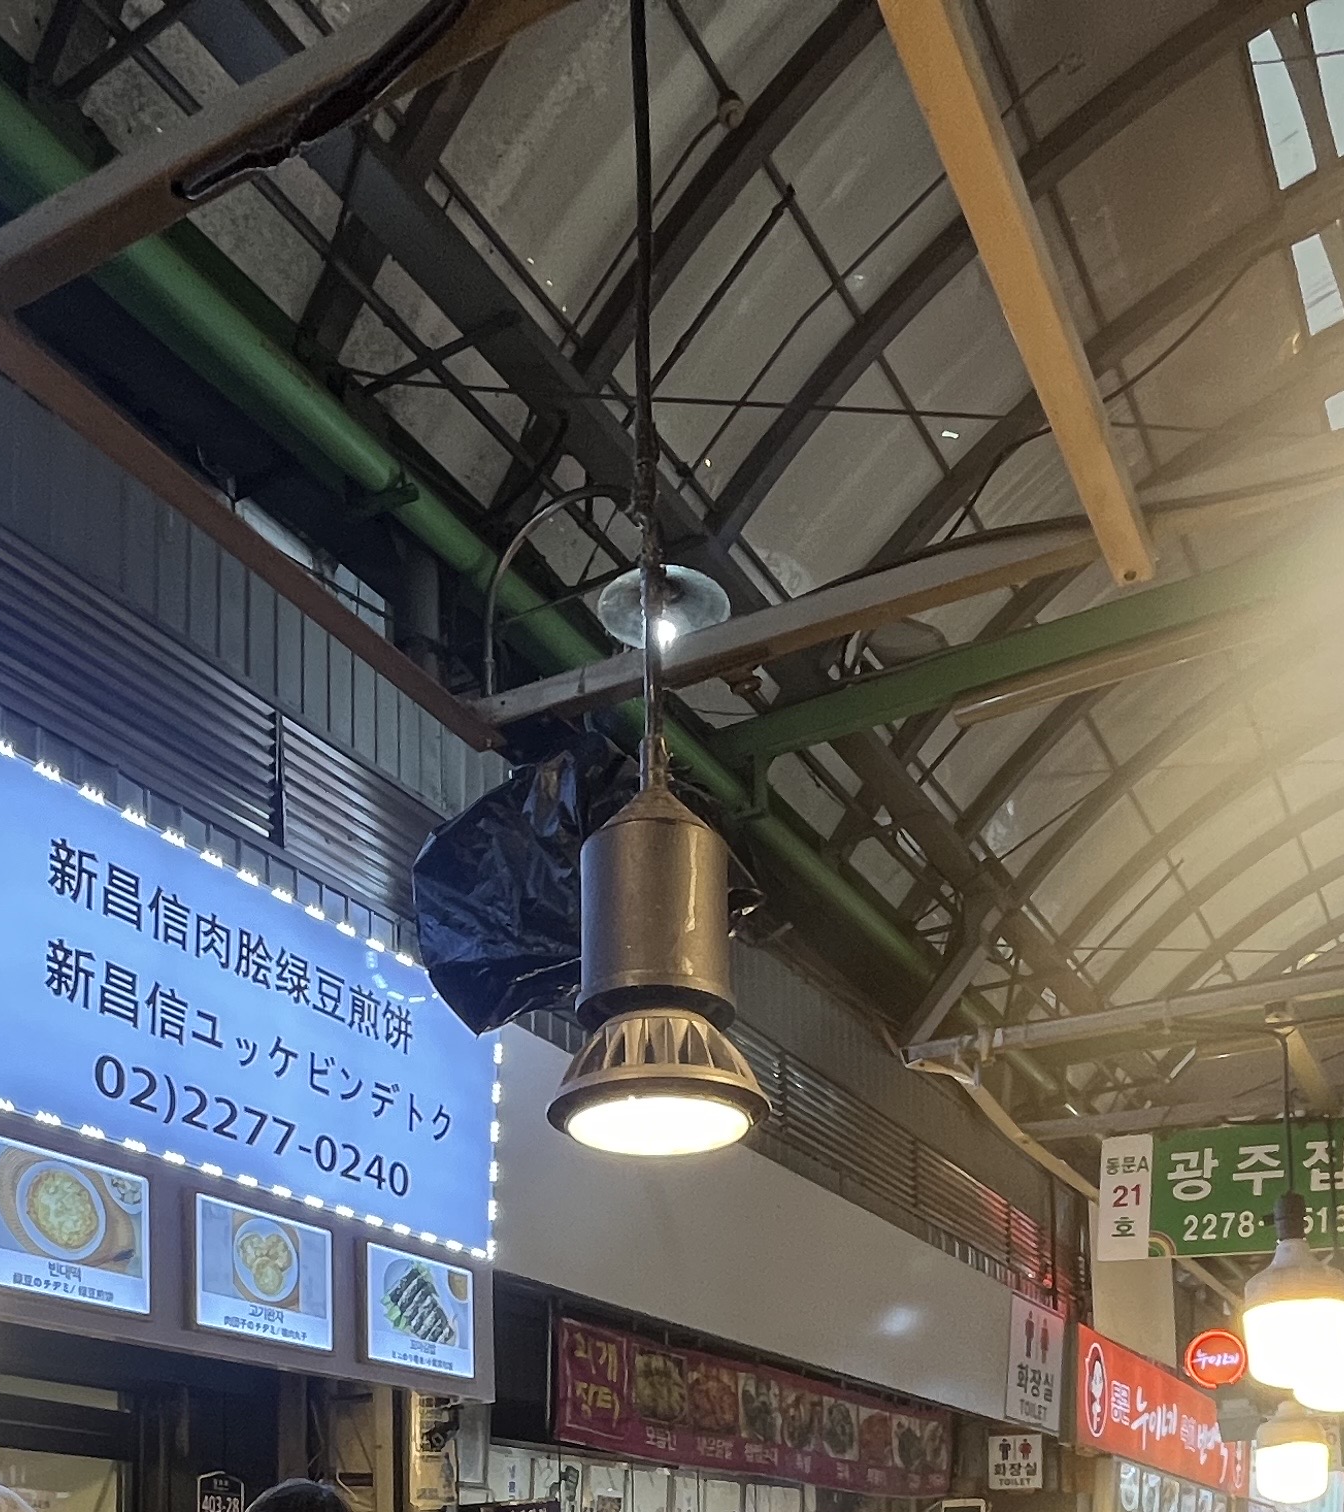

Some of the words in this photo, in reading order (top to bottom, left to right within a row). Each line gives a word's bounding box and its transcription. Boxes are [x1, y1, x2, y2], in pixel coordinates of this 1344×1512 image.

[48, 838, 413, 1054] 新昌信肉脍绿豆煎饼
[45, 938, 452, 1141] 新昌信ユッケビンデトク
[94, 1054, 409, 1197] 02)2277-0240
[1106, 1154, 1149, 1175] 동문A
[1112, 1184, 1142, 1207] 21
[1111, 1216, 1136, 1238] 호
[1016, 1363, 1054, 1403] 화장실
[1019, 1399, 1048, 1421] TOILET
[994, 1461, 1038, 1478] 화장실
[998, 1478, 1032, 1488] TOILET
